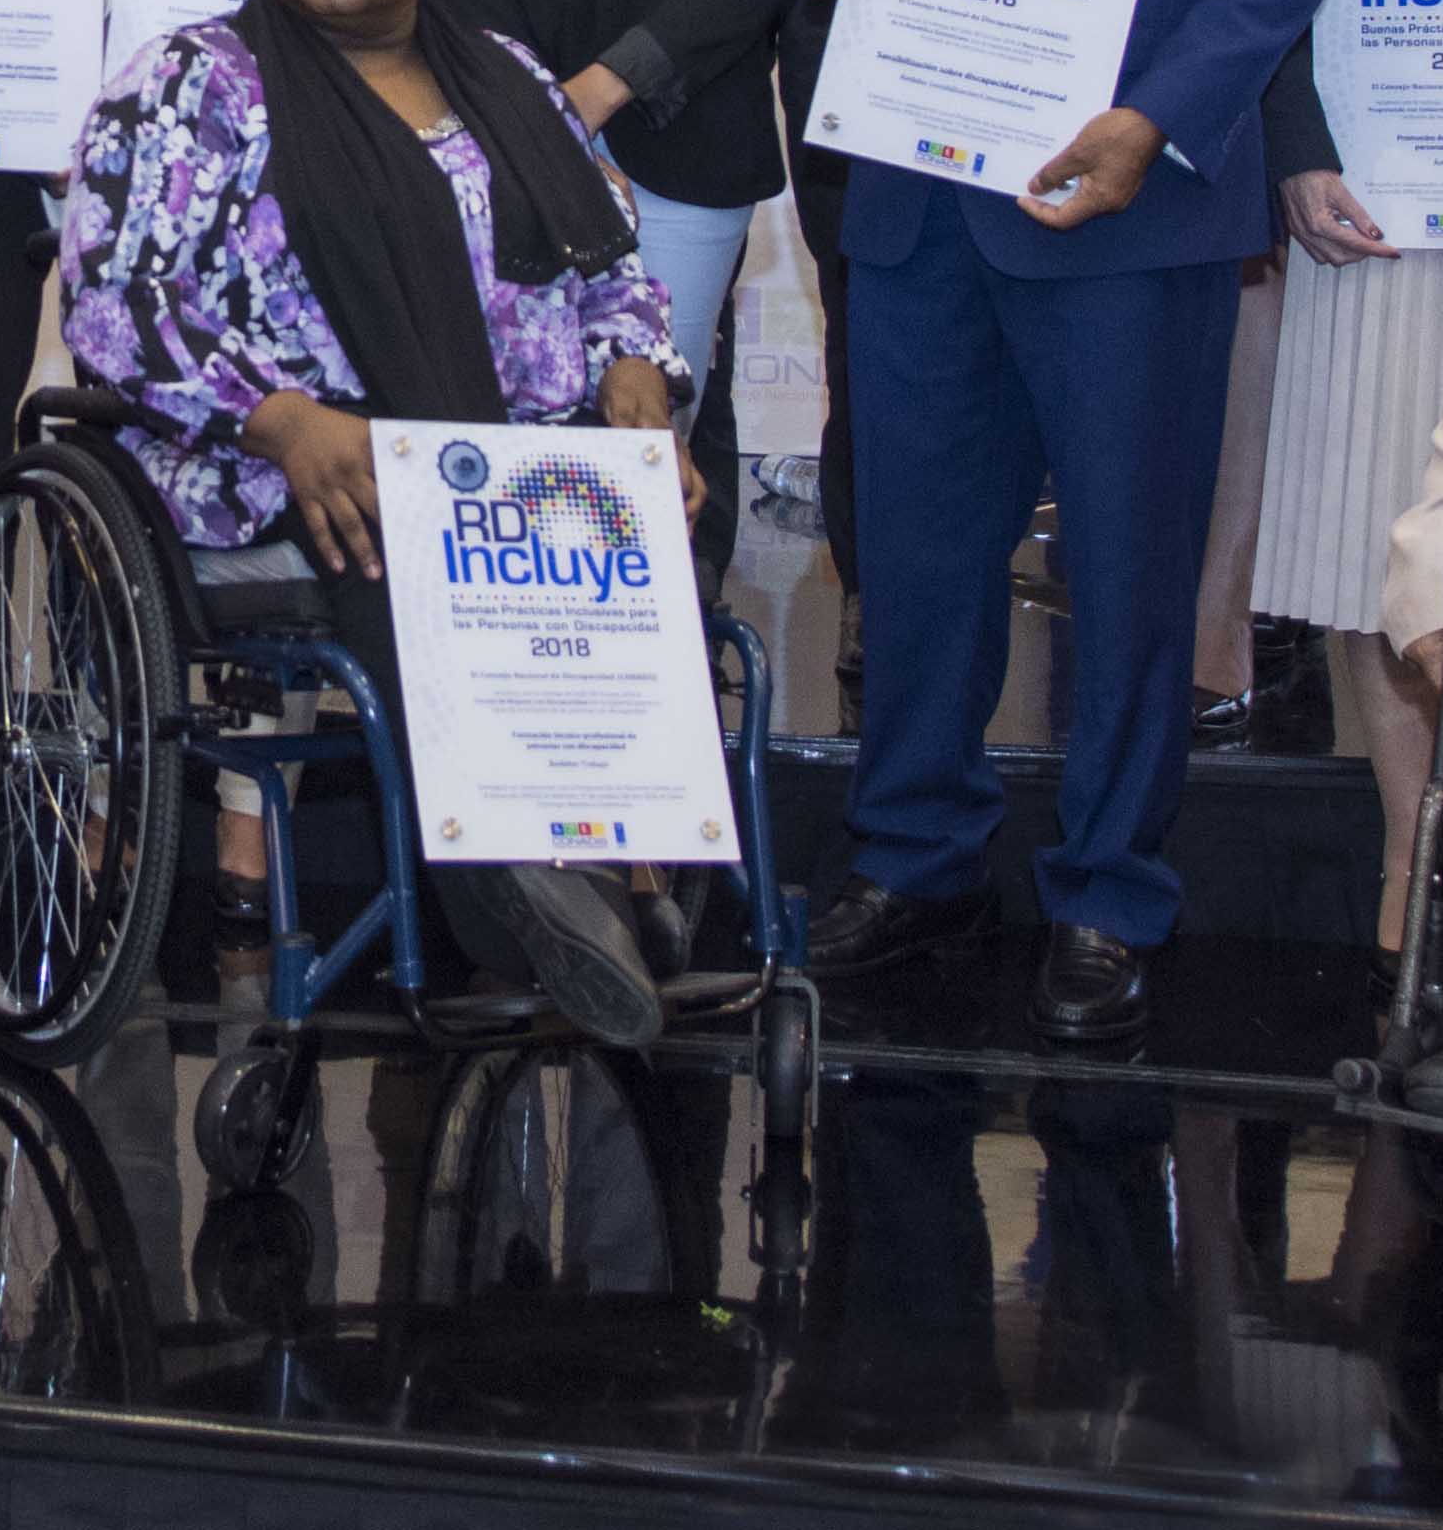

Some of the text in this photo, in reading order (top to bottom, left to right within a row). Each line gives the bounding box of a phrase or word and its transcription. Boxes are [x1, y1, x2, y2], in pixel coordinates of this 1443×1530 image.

[1361, 24, 1405, 34] Buenas
[1361, 37, 1379, 47] las
[1384, 37, 1442, 47] Personas
[452, 499, 529, 545] RD
[442, 529, 651, 603] Incluye
[530, 638, 590, 658] 2018
